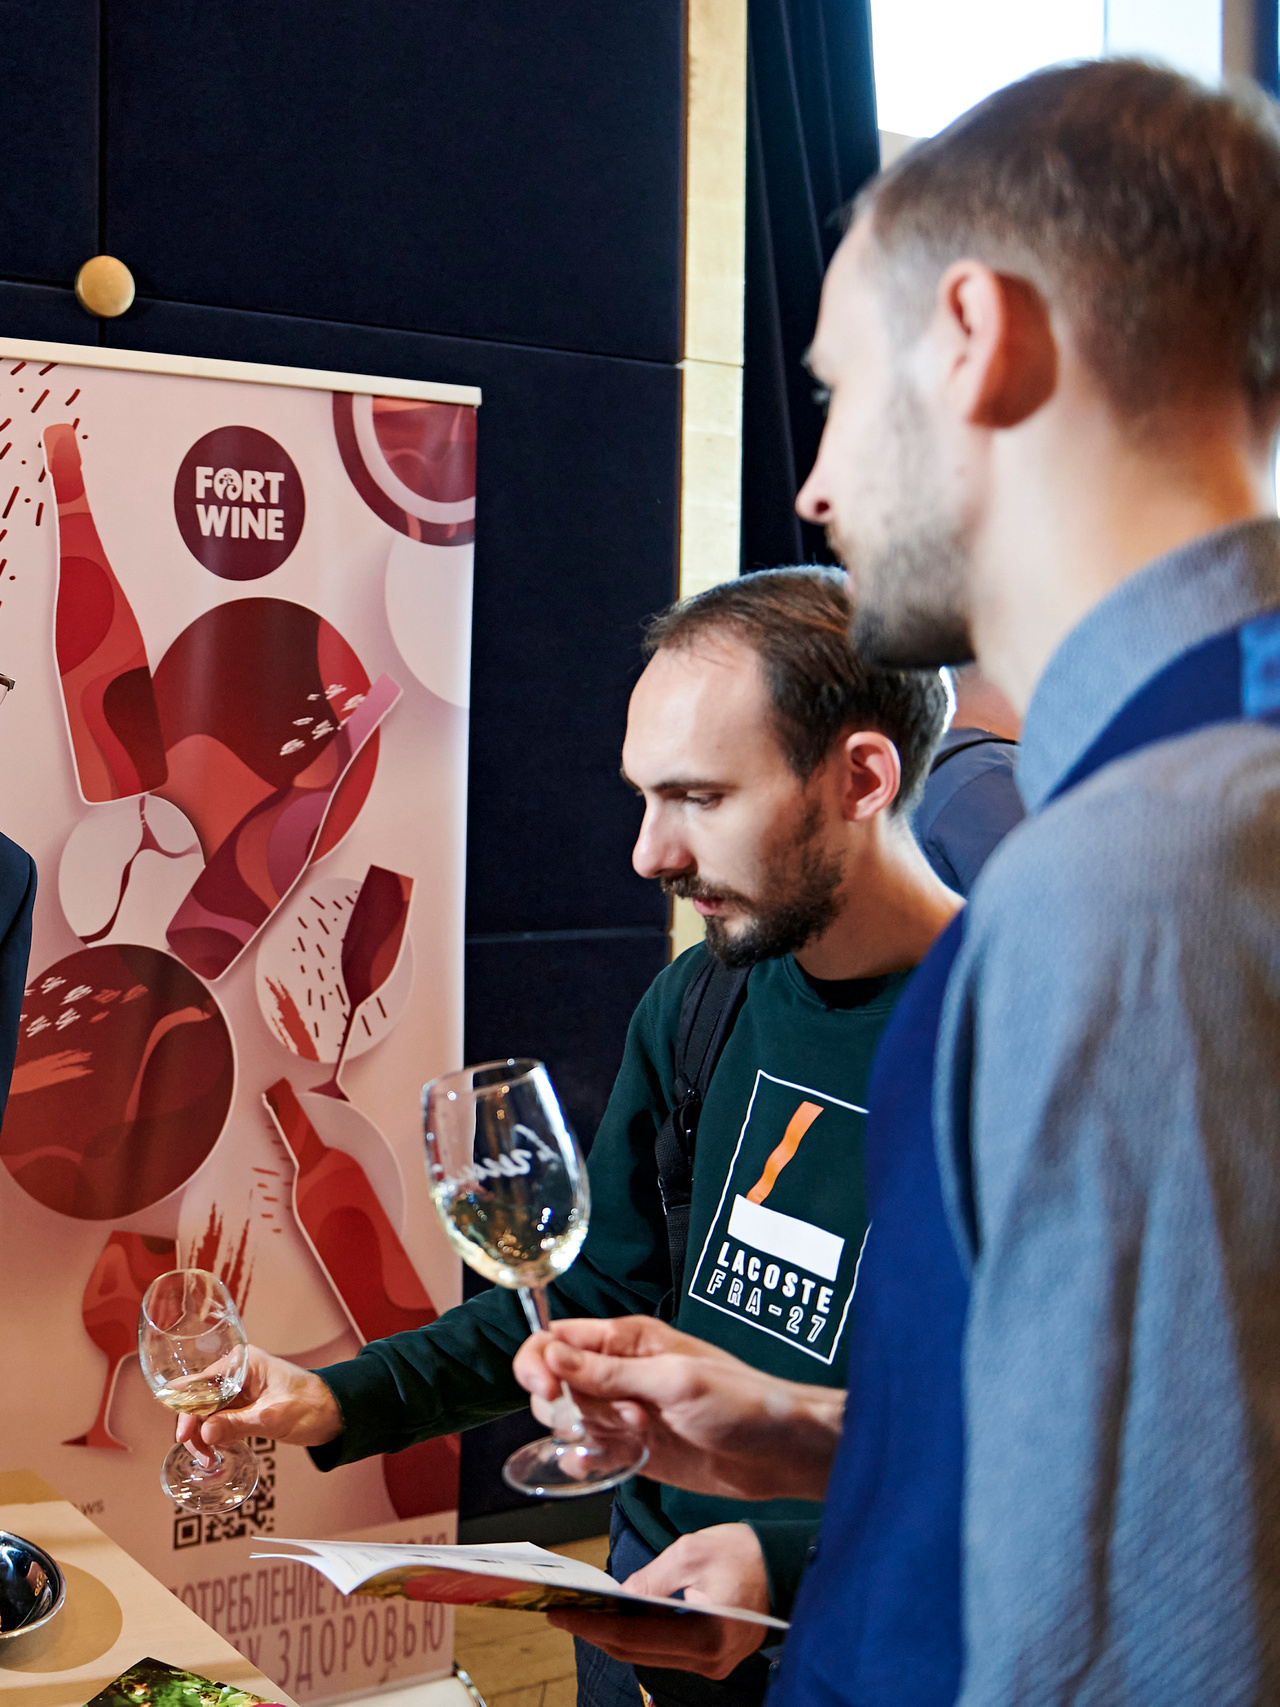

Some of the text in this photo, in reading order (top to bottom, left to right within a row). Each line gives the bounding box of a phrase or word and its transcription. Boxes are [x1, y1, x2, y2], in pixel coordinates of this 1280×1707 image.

[195, 466, 285, 504] FORT
[195, 504, 285, 541] WINE
[706, 1268, 827, 1344] FRA-27
[716, 1241, 834, 1314] LACOSTE
[277, 1601, 446, 1694] ЗДОРОВЬЮ
